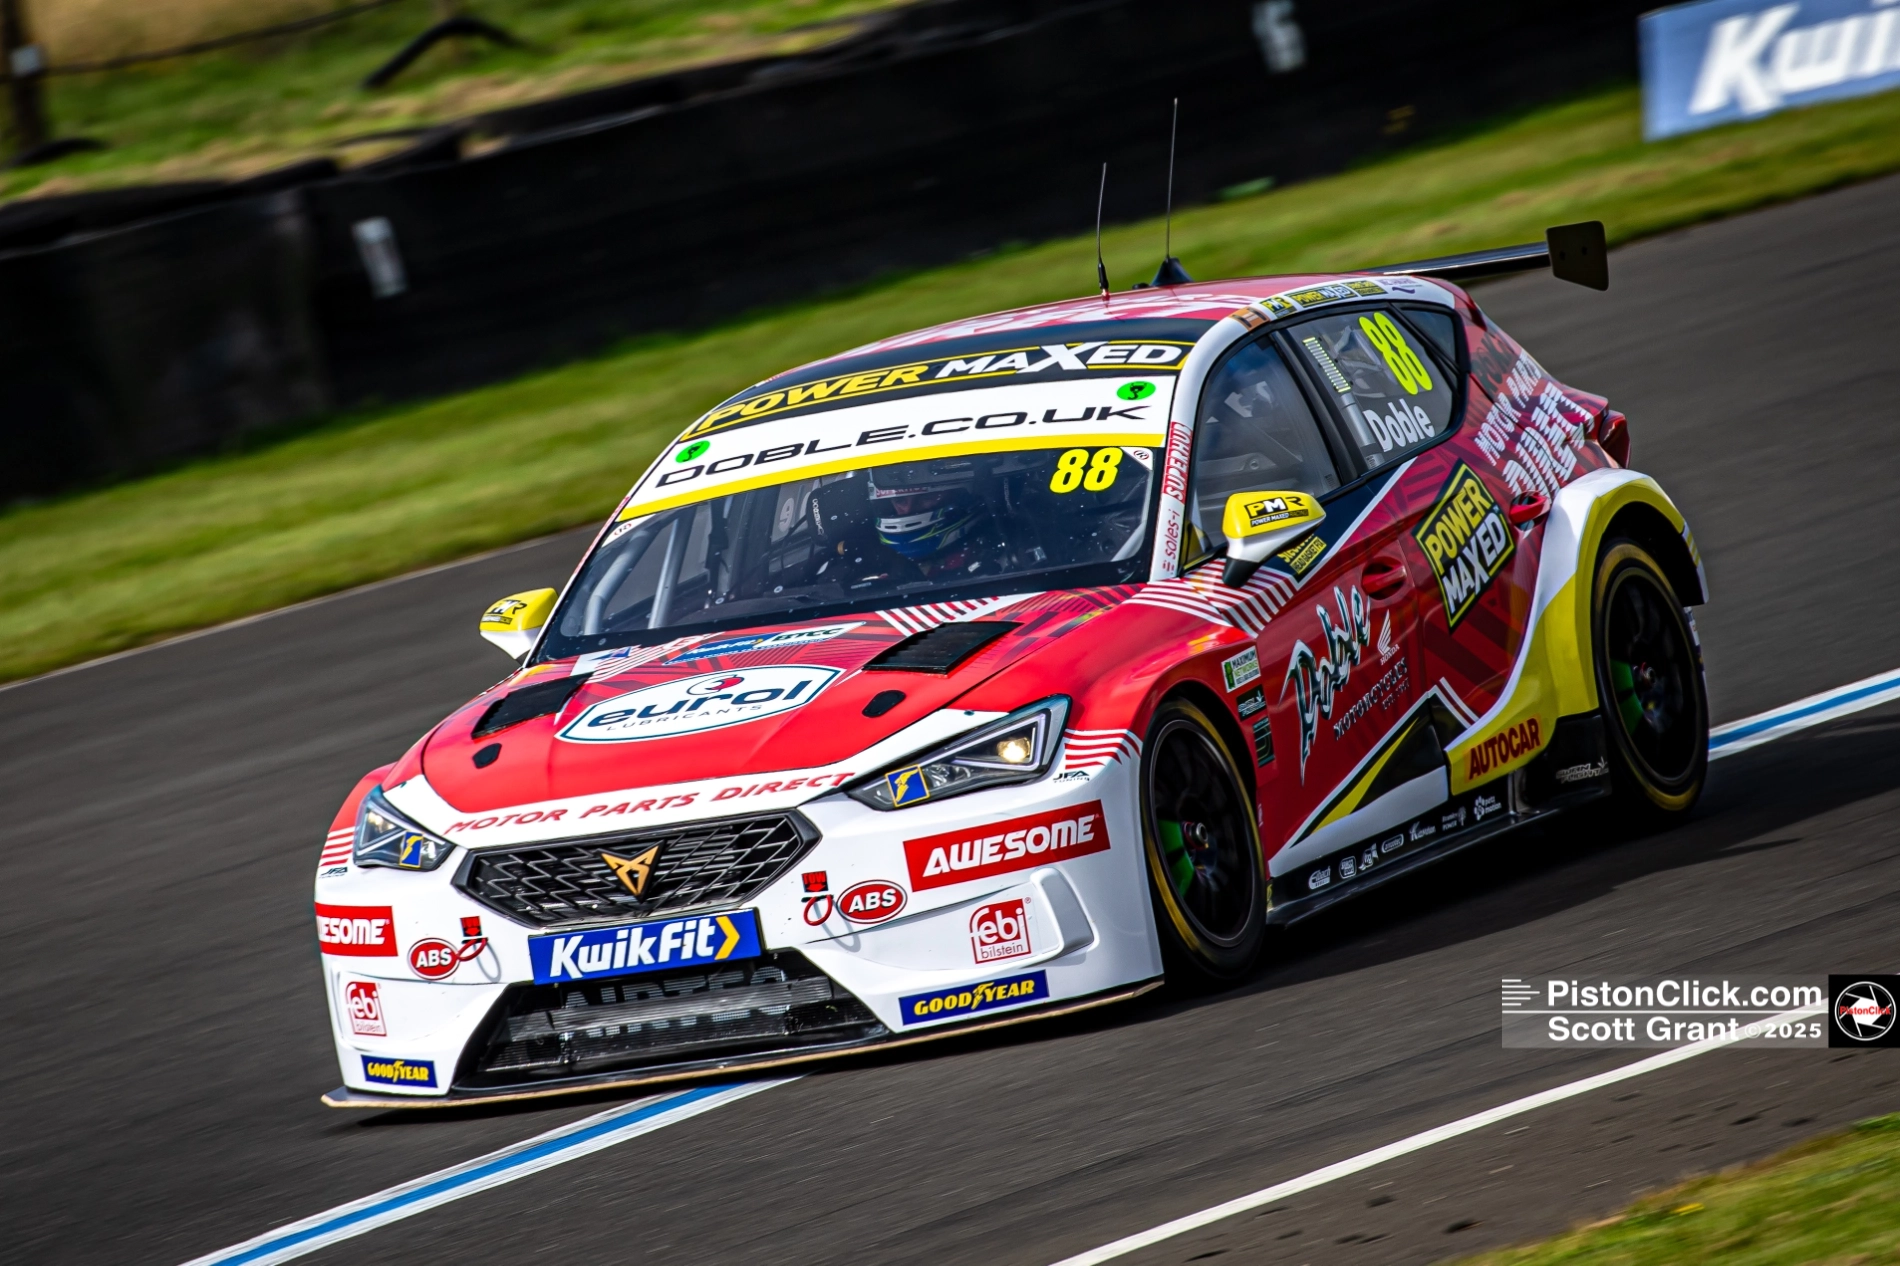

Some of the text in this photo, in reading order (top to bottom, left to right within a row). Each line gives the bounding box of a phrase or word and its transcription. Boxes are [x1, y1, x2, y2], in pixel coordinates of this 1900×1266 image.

[1358, 312, 1433, 395] 88
[699, 341, 1182, 430] POWER MAXED
[1362, 399, 1435, 452] Doble
[655, 405, 1150, 488] DOBLE.CO.UK
[1050, 448, 1123, 494] 88
[1245, 496, 1305, 518] PMR
[1252, 516, 1271, 526] POWER
[1423, 477, 1496, 575] POWER
[1441, 513, 1514, 614] MAXED
[1380, 644, 1400, 665] HONDA
[1278, 584, 1372, 786] Doble
[587, 680, 800, 727] eurol
[604, 706, 762, 730] LUBRICANTS
[1468, 718, 1541, 780] AUTOCAR
[1053, 770, 1089, 781] JFA
[444, 773, 856, 834] MOTOR PARTS DIRECT
[922, 814, 1095, 877] AWESOME
[321, 867, 348, 876] JFA
[848, 889, 897, 913] ABS
[316, 918, 386, 945] ESOME
[970, 908, 1026, 944] febi
[414, 946, 452, 969] ABS
[980, 942, 1024, 959] bilstein
[346, 983, 380, 1019] febi
[914, 980, 1035, 1015] GOODYEAR
[368, 1061, 429, 1082] GOODYEAR
